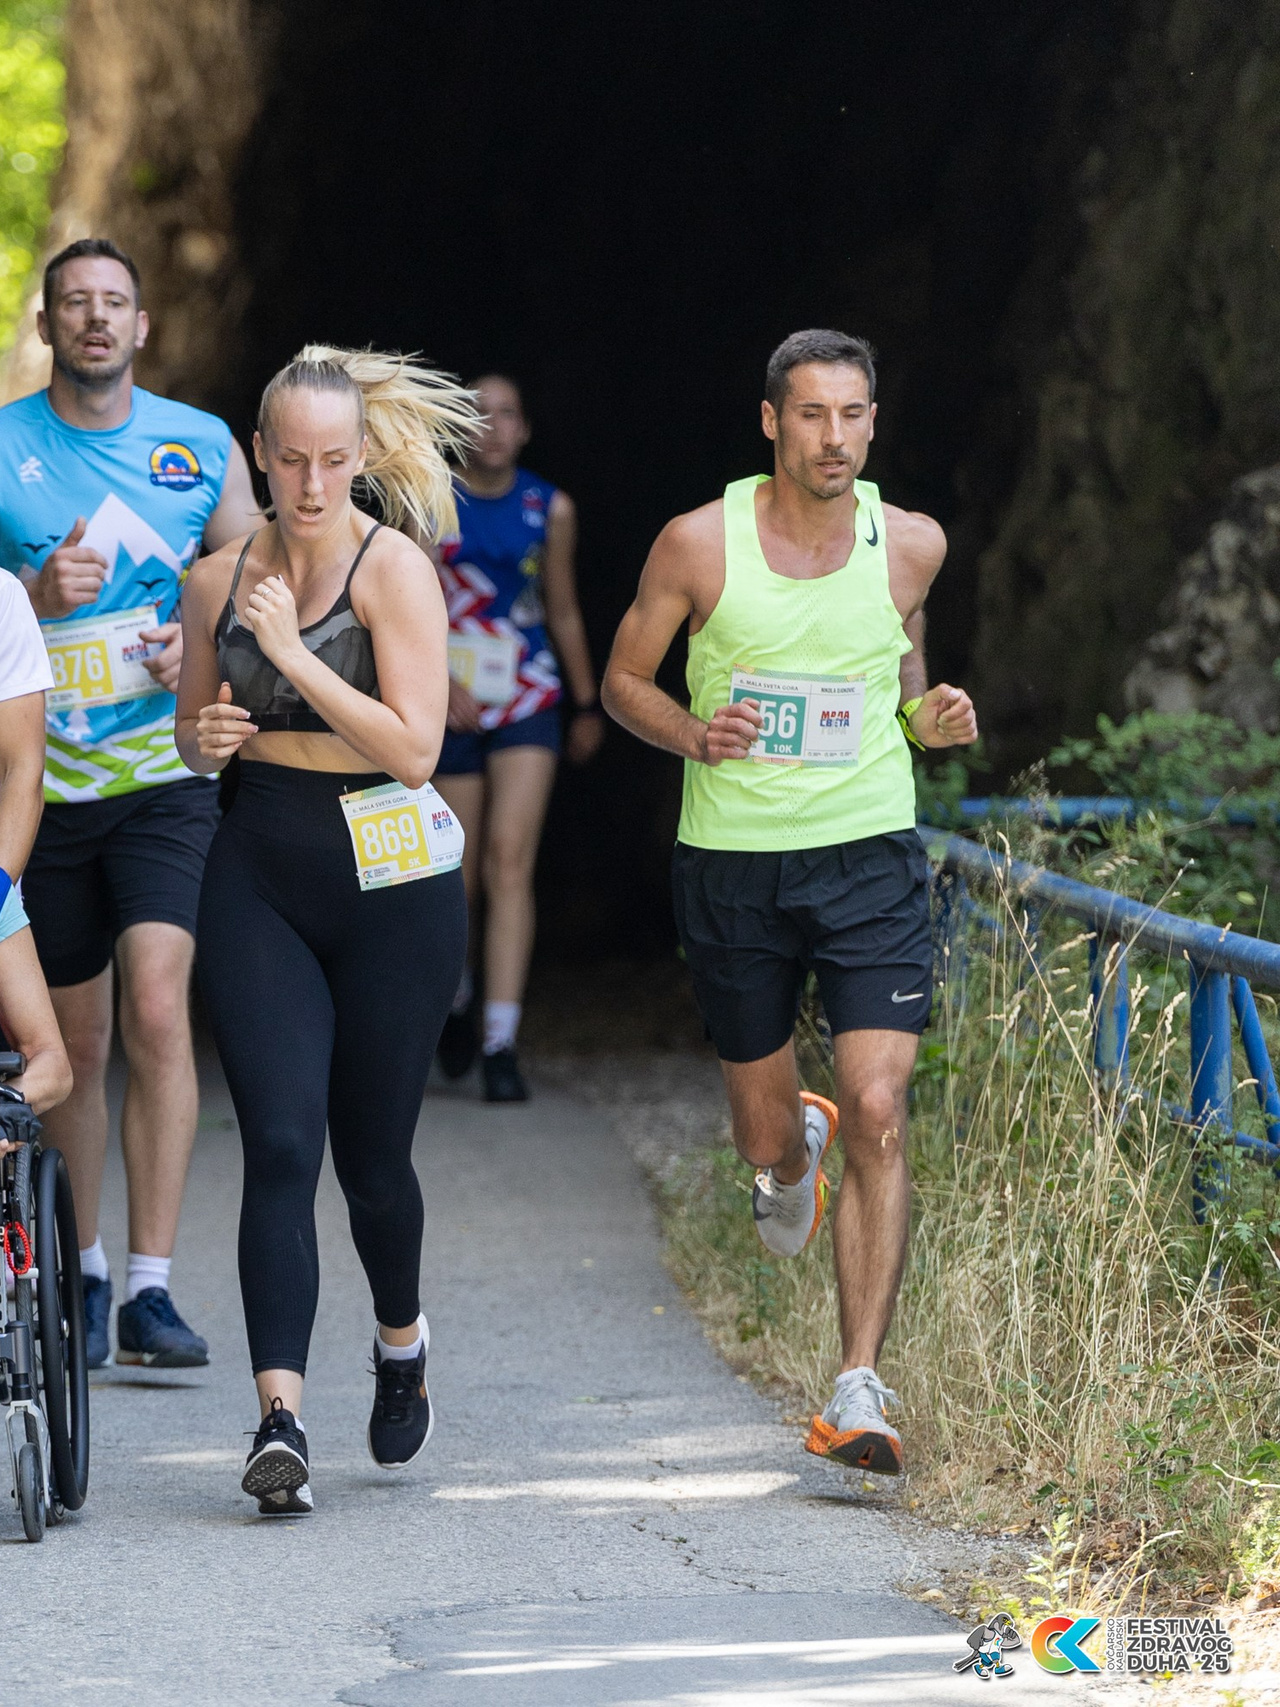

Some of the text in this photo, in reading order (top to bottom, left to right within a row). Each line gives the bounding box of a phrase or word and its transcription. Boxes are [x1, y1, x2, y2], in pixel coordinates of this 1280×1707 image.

[49, 646, 105, 687] 876
[741, 696, 797, 739] 56
[773, 744, 793, 753] 10K
[359, 803, 375, 811] MALA
[375, 799, 392, 808] SVETA
[361, 813, 420, 860] 869
[408, 857, 421, 868] 5K
